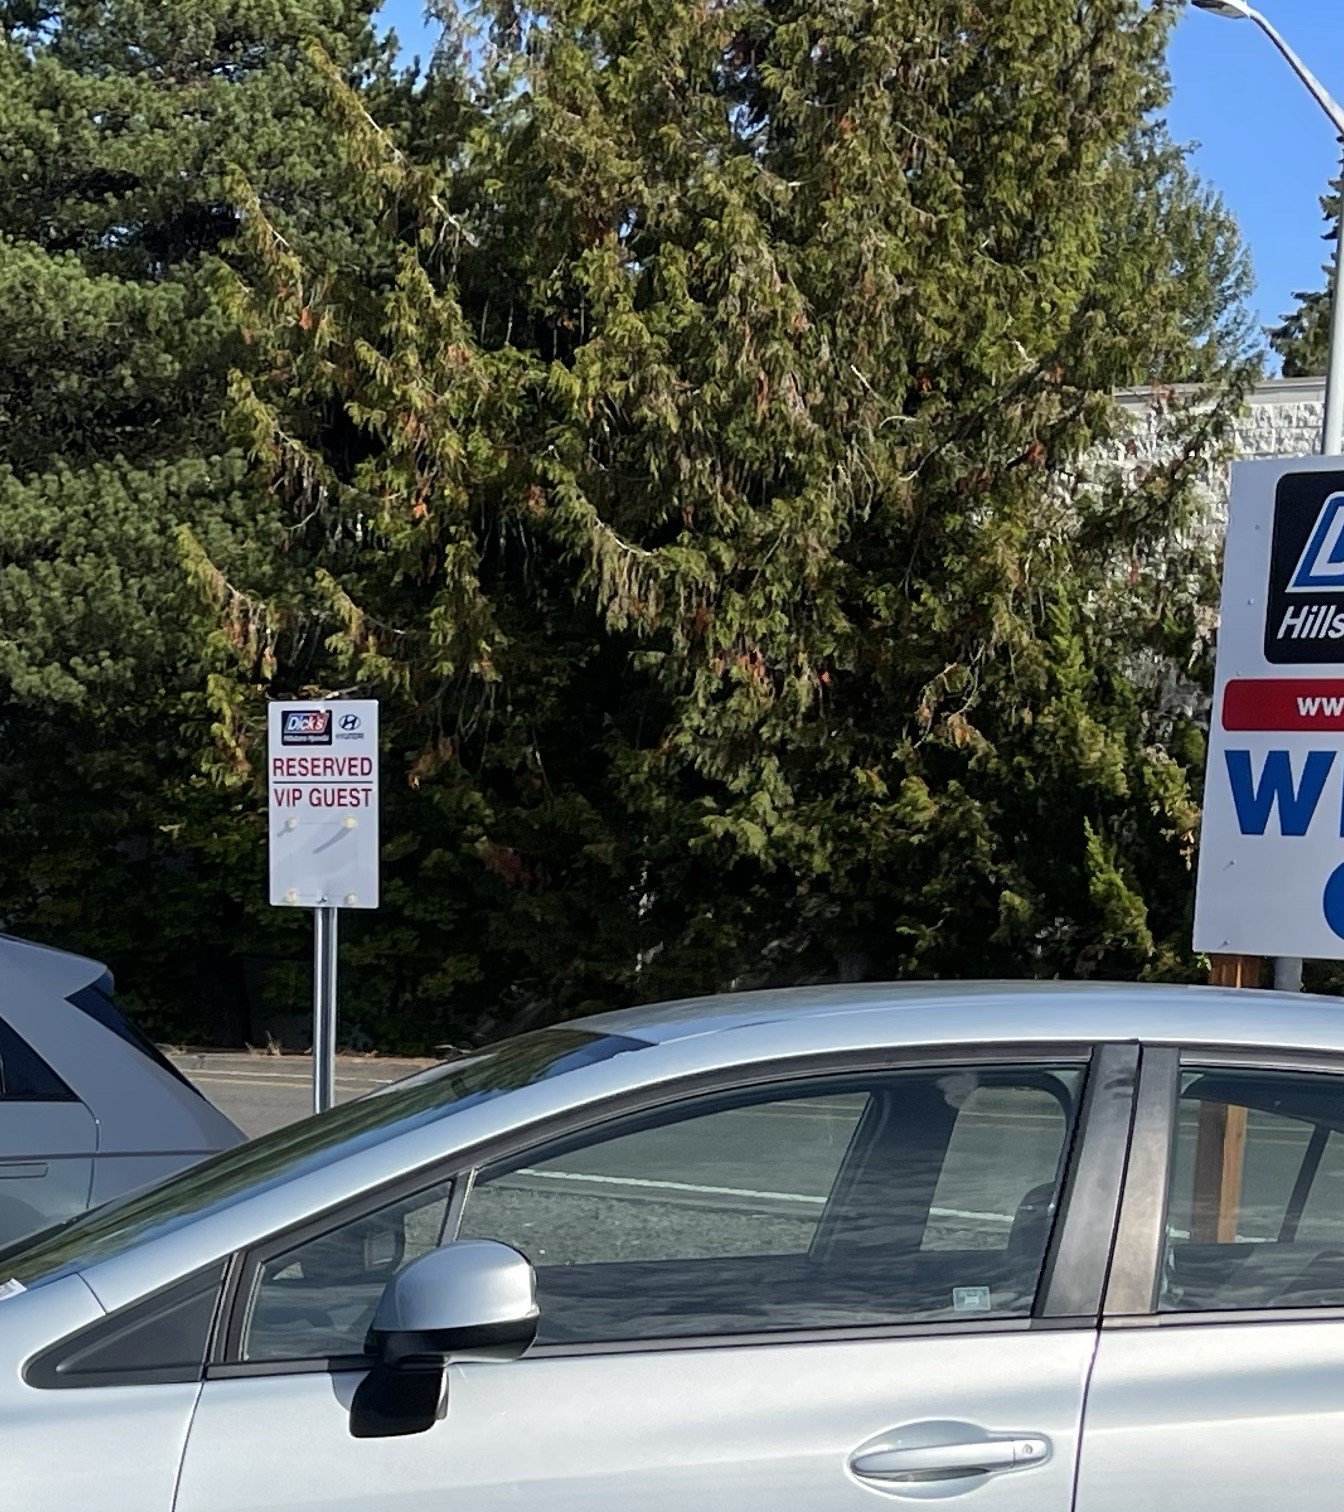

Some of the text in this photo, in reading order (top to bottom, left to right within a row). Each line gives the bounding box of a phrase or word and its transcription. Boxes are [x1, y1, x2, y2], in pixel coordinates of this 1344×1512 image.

[273, 757, 373, 777] RESERVED
[274, 788, 373, 808] VIP GUEST
